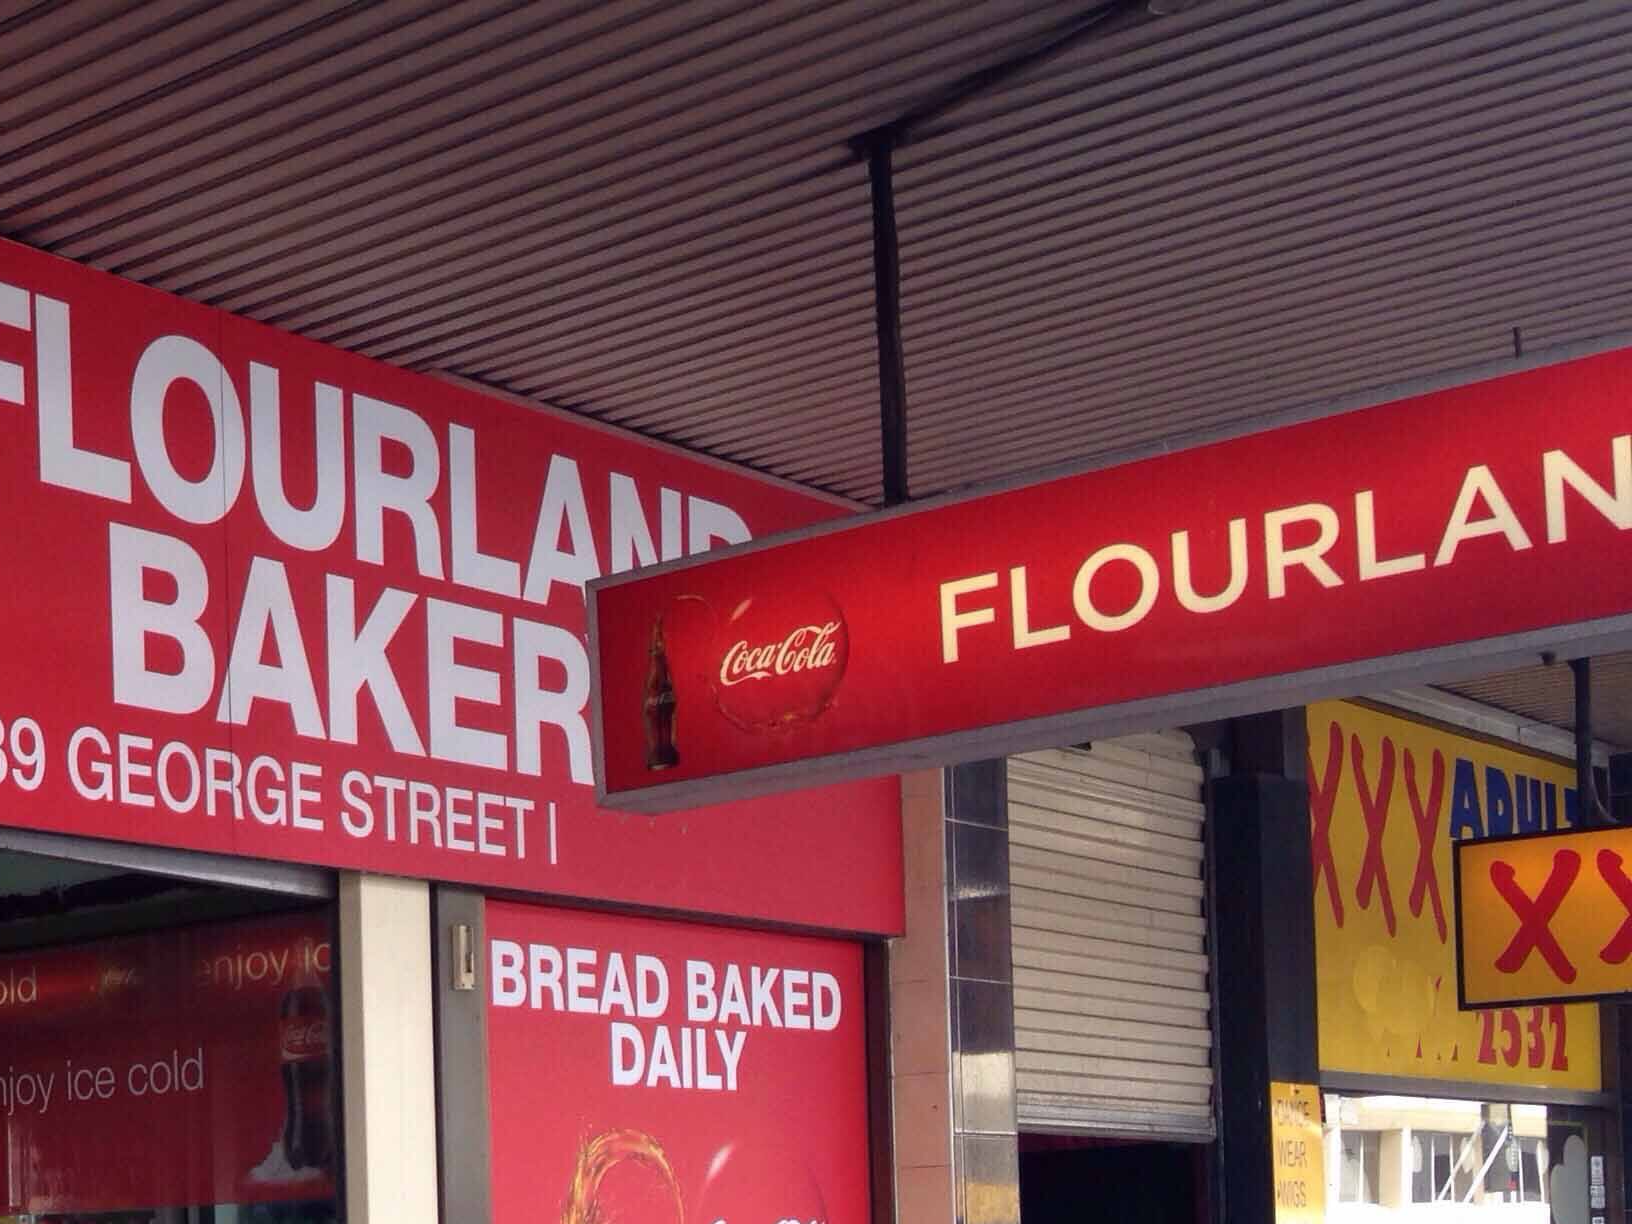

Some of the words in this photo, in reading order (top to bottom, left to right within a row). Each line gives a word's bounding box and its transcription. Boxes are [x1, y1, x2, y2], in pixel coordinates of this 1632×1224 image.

[939, 432, 1632, 664] FLOURLAN
[109, 522, 596, 787] BAKER
[720, 621, 840, 686] Coca-Cola
[67, 727, 324, 832] GEORGE
[341, 769, 536, 859] STREET
[490, 939, 670, 1019] BREAD
[685, 959, 843, 1032] BAKED
[67, 1059, 116, 1102] ice
[128, 1047, 205, 1096] cold
[610, 1022, 748, 1091] DAILY
[1279, 1140, 1308, 1168] WEAR
